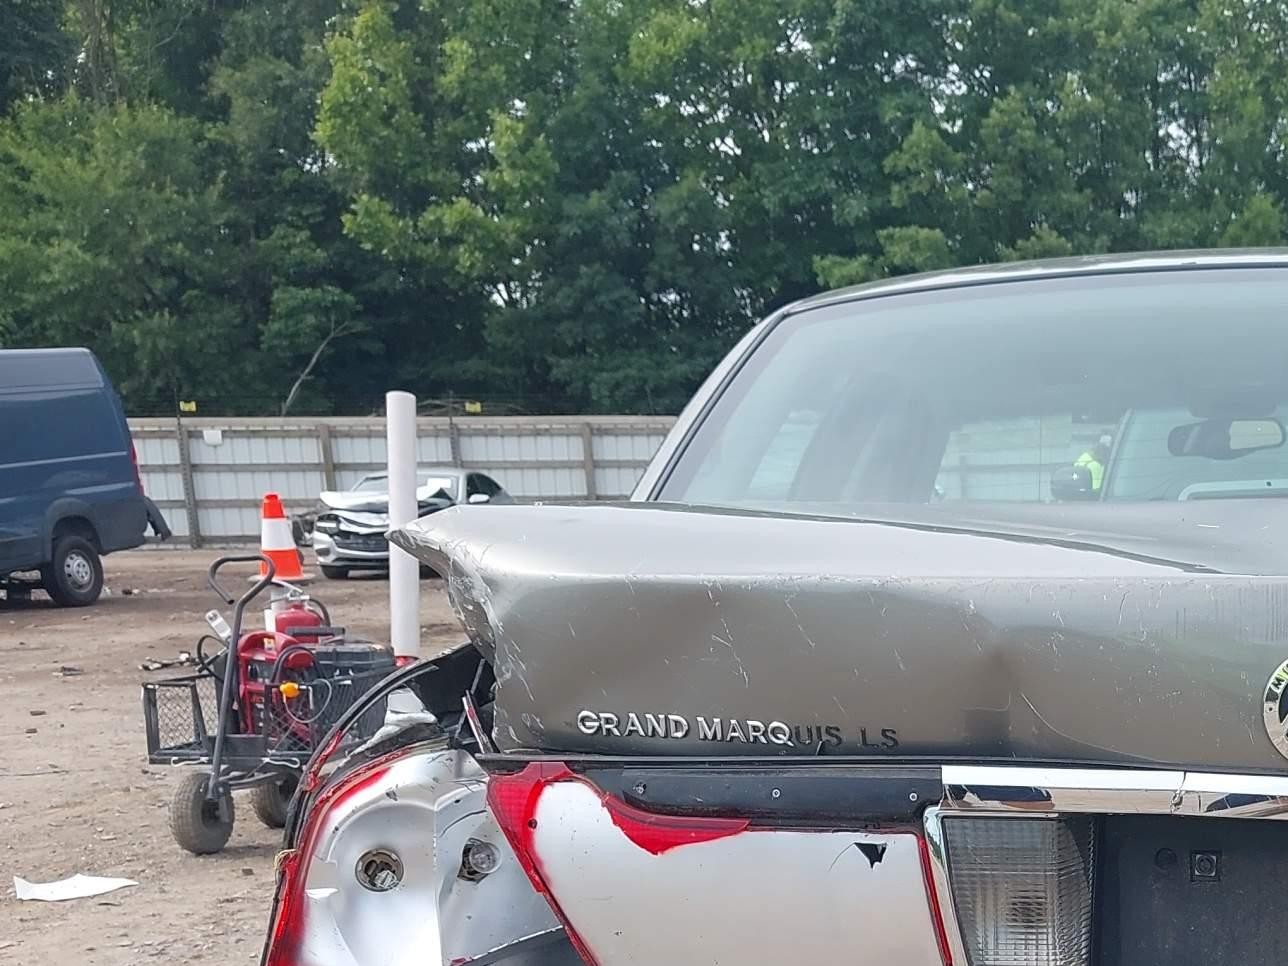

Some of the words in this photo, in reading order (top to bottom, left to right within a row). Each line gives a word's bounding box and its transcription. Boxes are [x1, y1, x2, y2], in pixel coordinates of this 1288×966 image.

[577, 709, 690, 739] GRAND
[696, 716, 844, 747] MARQUIS
[859, 727, 900, 749] LS
